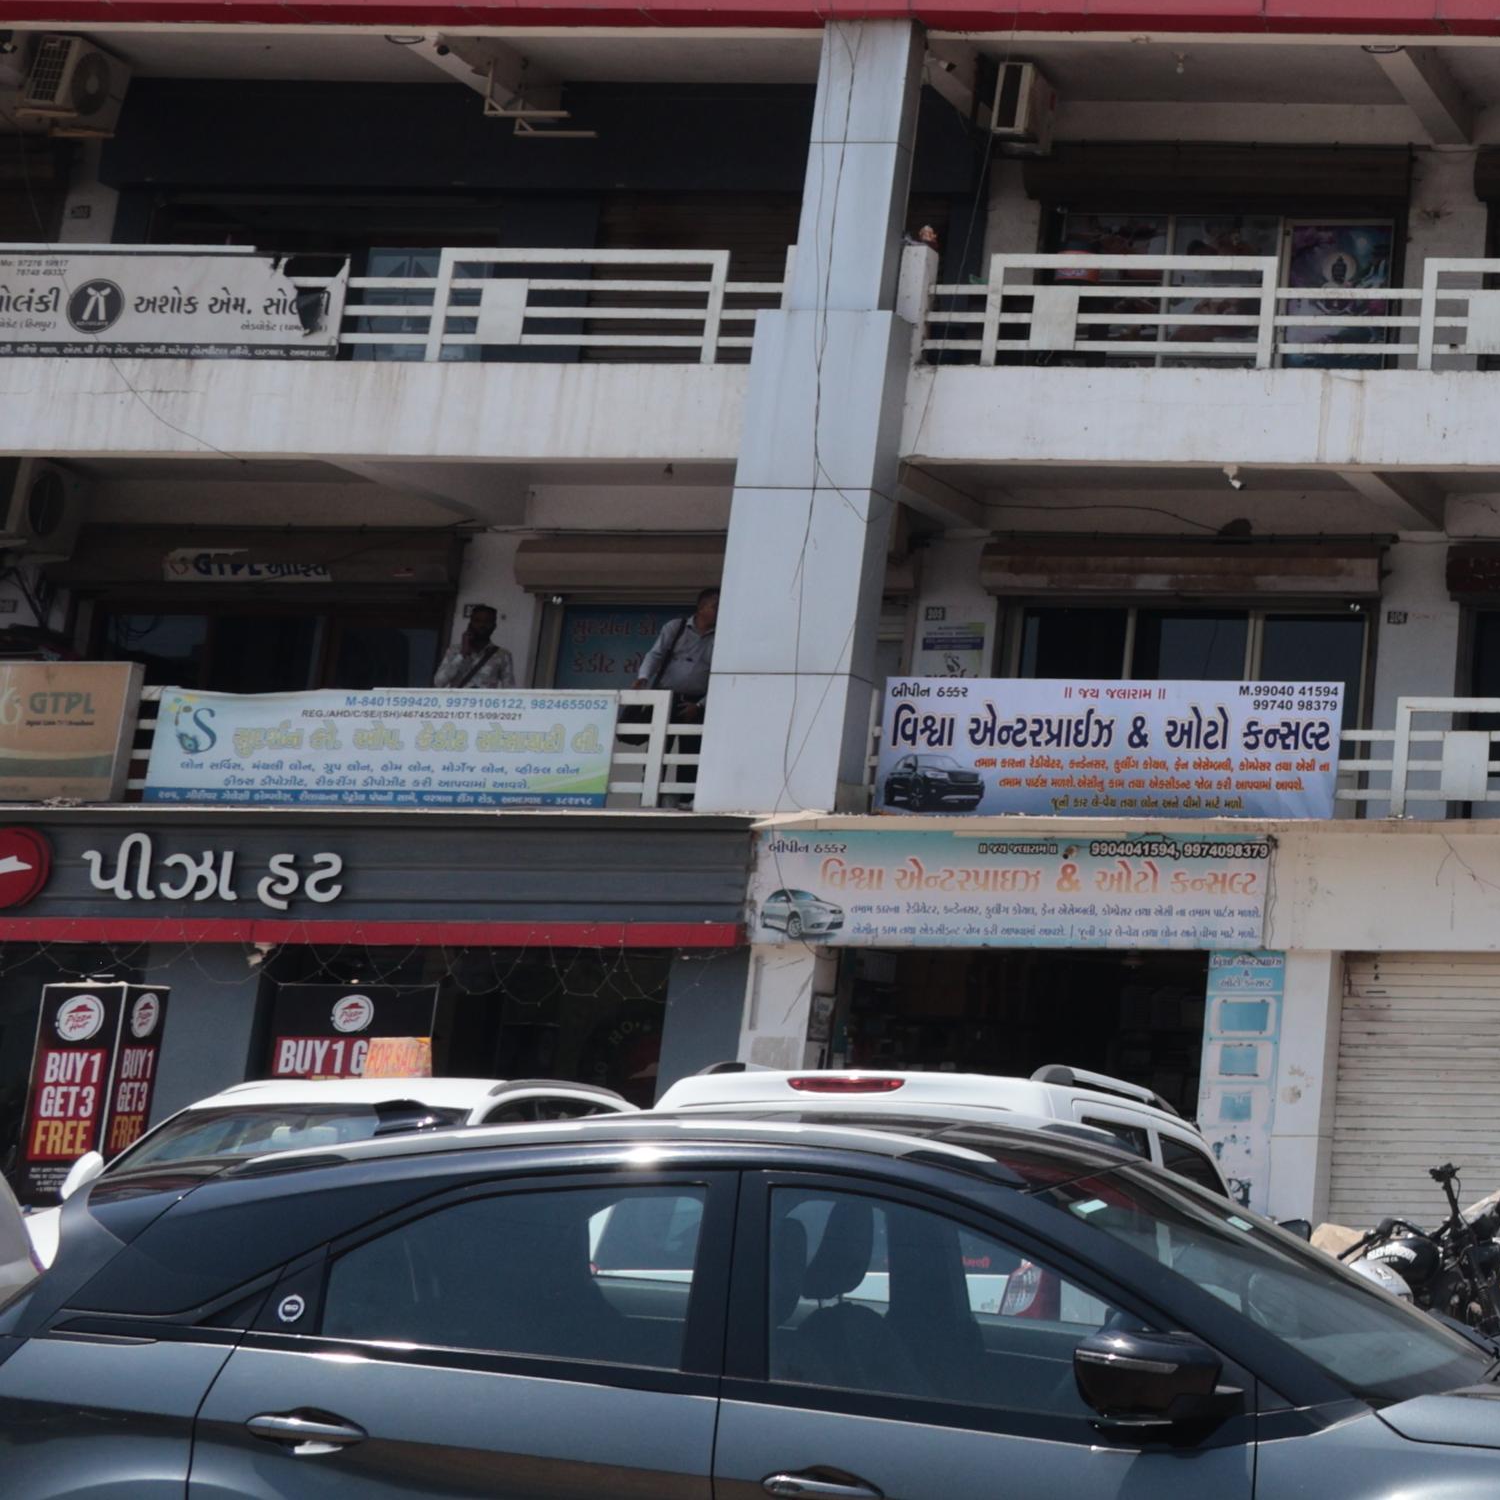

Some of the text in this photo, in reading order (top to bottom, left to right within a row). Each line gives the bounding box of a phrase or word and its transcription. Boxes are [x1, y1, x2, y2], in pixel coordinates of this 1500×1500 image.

[134, 286, 253, 315] અશોક એમ.
[28, 691, 96, 716] GTPL
[891, 682, 931, 698] બીપીન
[1105, 687, 1153, 700] જલારામ
[1238, 685, 1339, 698] M.99040 41594
[530, 699, 608, 712] 9824655052
[1252, 700, 1338, 712] 99740 98379
[1128, 715, 1150, 749] &
[1165, 706, 1229, 750] ઓટો
[1089, 841, 1269, 859] 9904041594, 9974098379
[81, 832, 344, 910] પીઝા હટ
[1056, 862, 1082, 893] &
[1094, 860, 1160, 894] ઓટો
[278, 1039, 330, 1074] BUY
[332, 1040, 344, 1074] 1
[39, 1086, 80, 1117] GET
[33, 1120, 91, 1156] FREE
[110, 1114, 145, 1150] FREE
